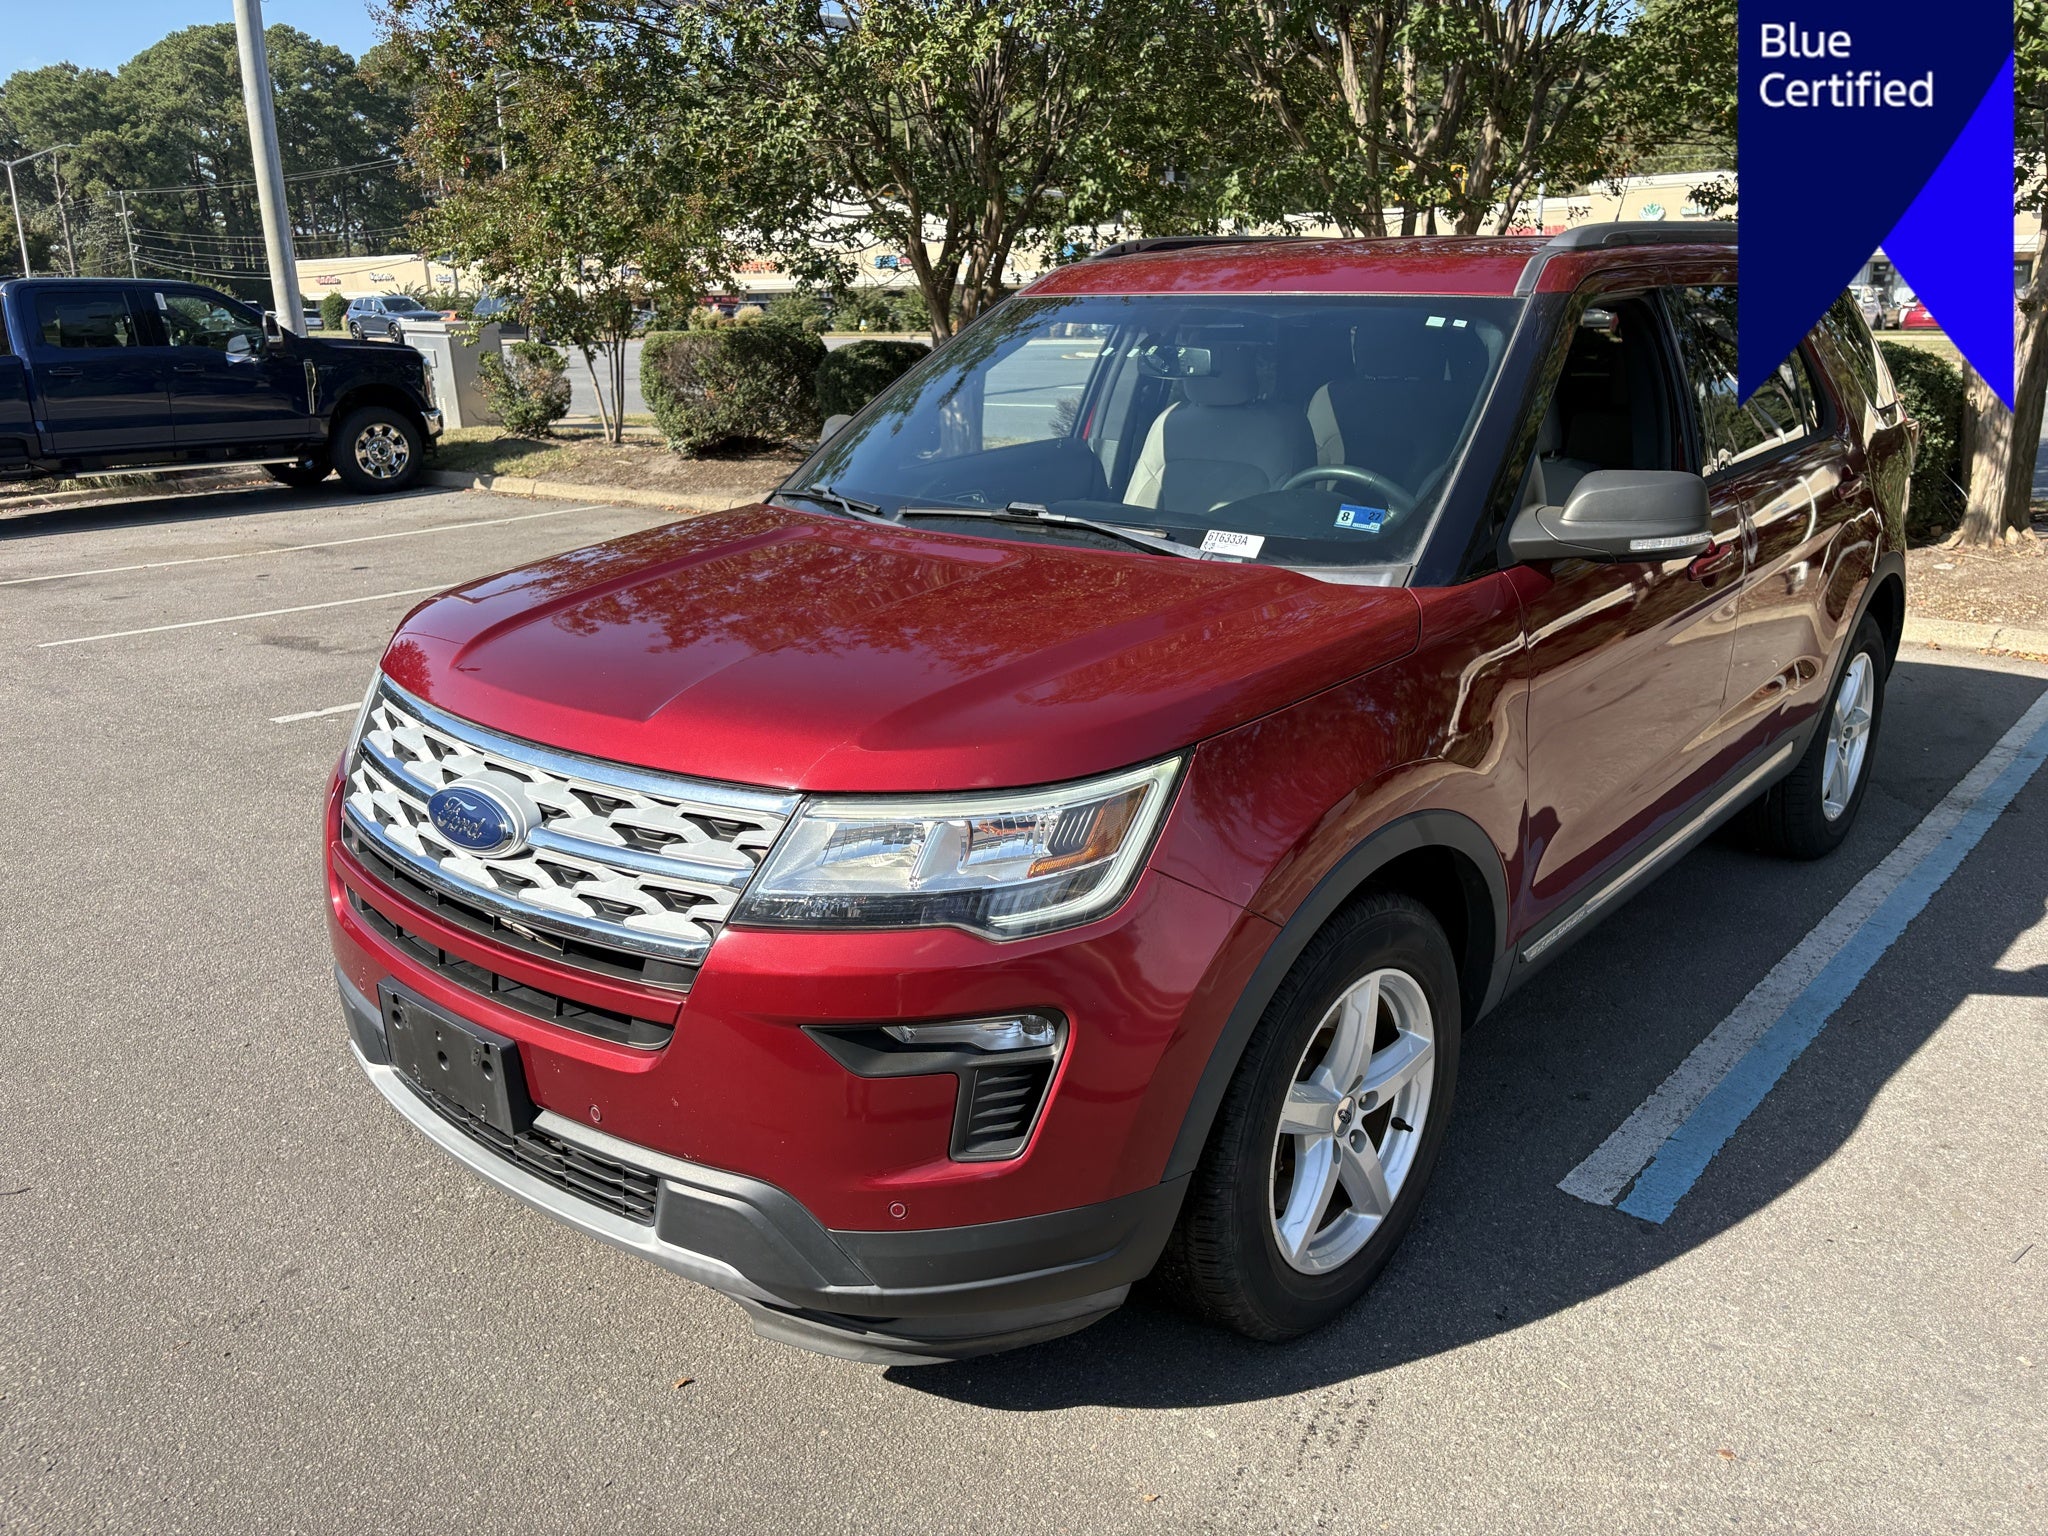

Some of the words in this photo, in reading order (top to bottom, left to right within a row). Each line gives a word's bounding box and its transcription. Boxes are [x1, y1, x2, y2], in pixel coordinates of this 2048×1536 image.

[1341, 511, 1350, 522] 8
[1368, 511, 1381, 521] 27
[1207, 531, 1248, 546] 6T6333A
[437, 796, 487, 840] Ford
